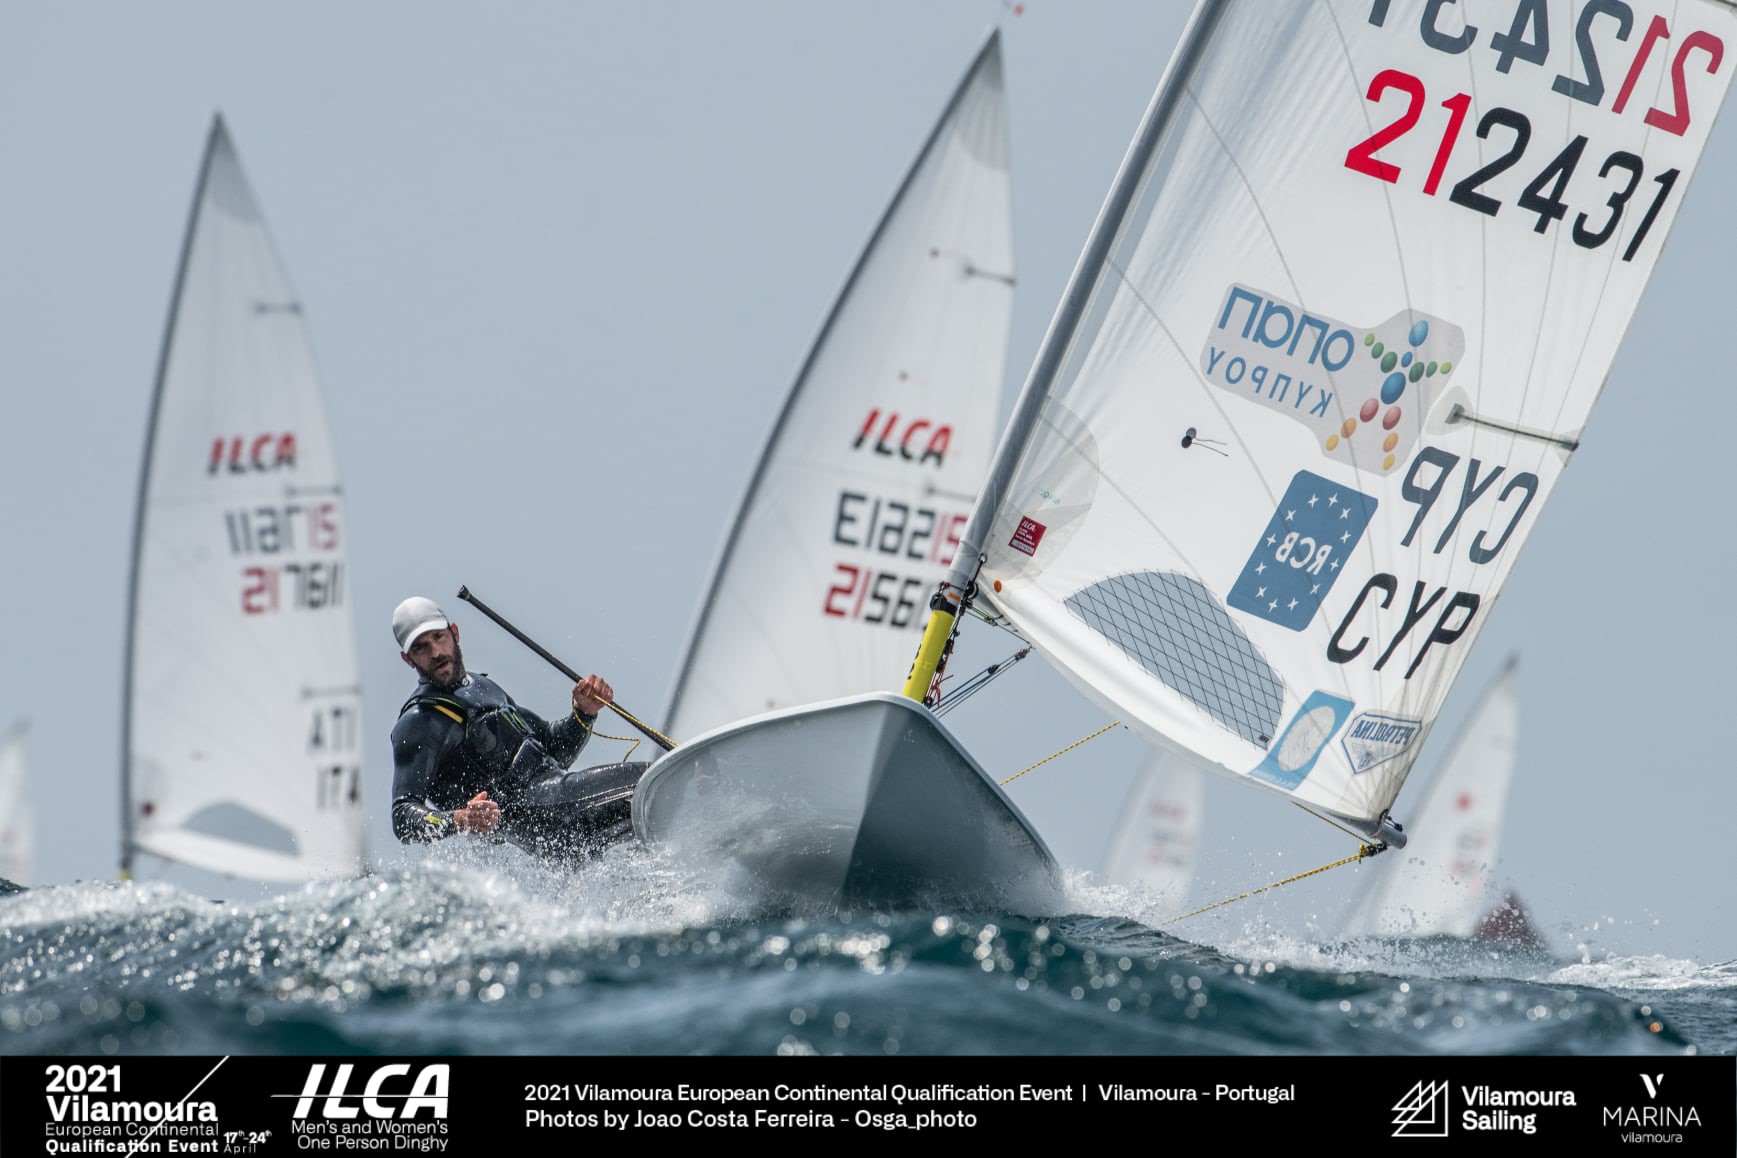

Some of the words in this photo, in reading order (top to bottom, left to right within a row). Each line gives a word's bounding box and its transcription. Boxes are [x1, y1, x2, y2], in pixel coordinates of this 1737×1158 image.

[1344, 69, 1681, 263] 212431
[206, 432, 297, 477] ILCA
[852, 406, 955, 467] ILCA
[1327, 573, 1481, 680] CYP
